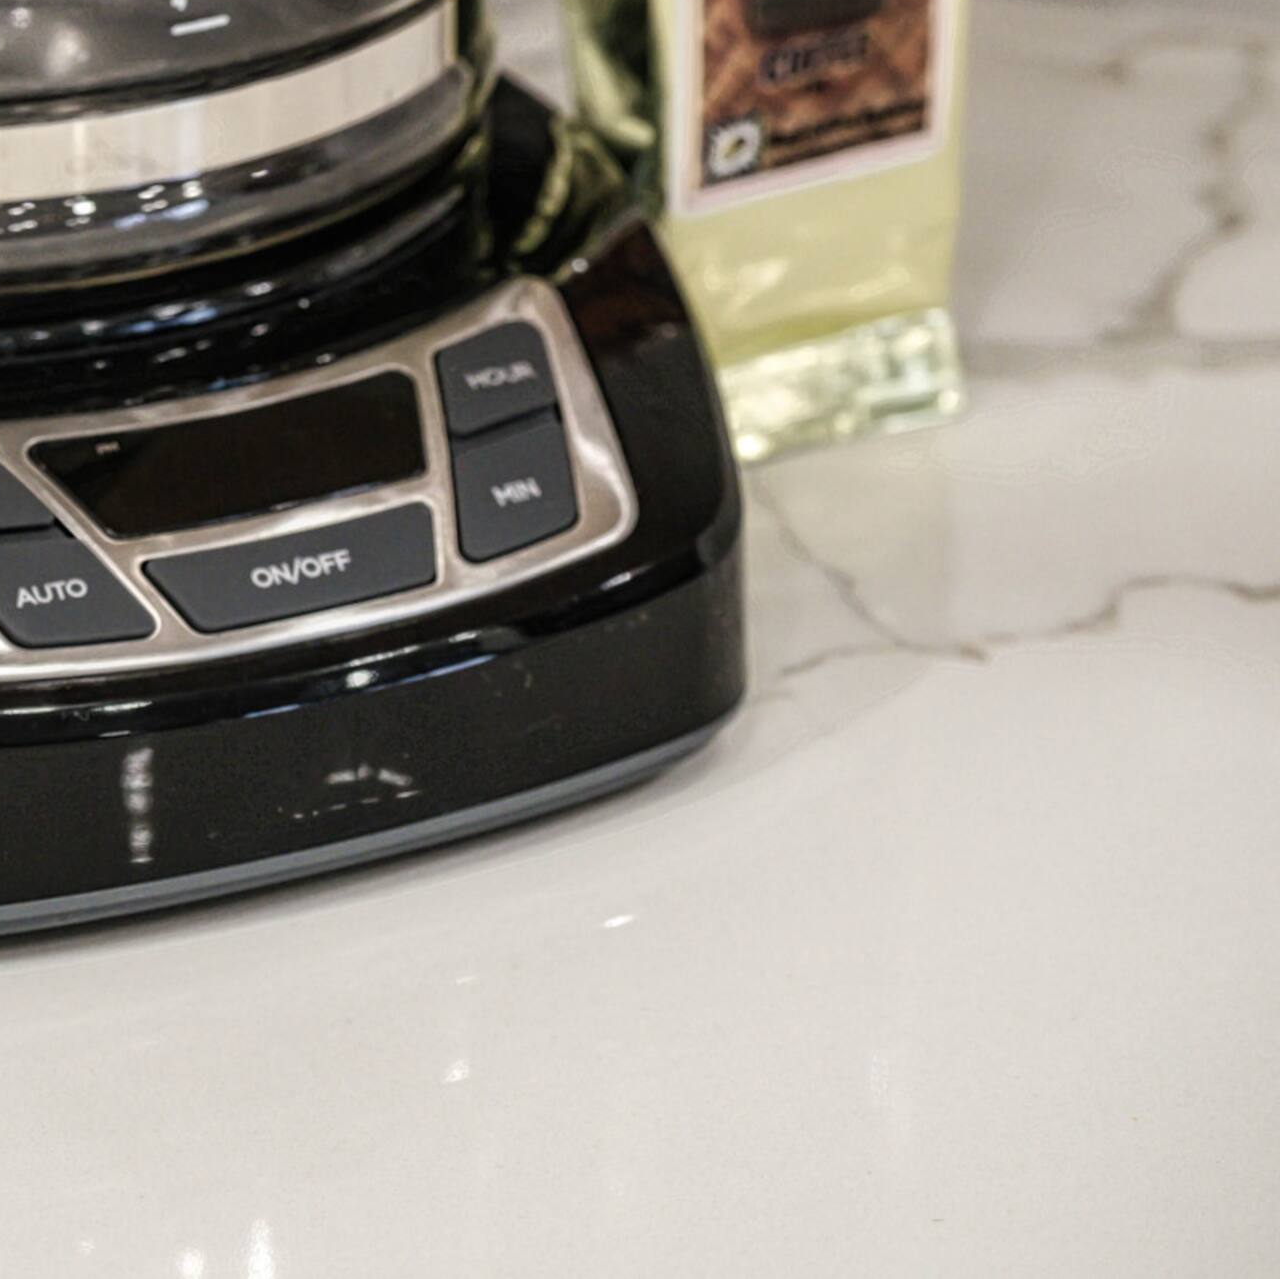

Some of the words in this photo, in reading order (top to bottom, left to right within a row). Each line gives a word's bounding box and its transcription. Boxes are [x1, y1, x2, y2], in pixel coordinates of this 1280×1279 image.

[464, 360, 537, 392] HOUR
[490, 476, 543, 508] MIN
[249, 547, 352, 589] ON/OFF
[16, 577, 88, 609] AUTO
